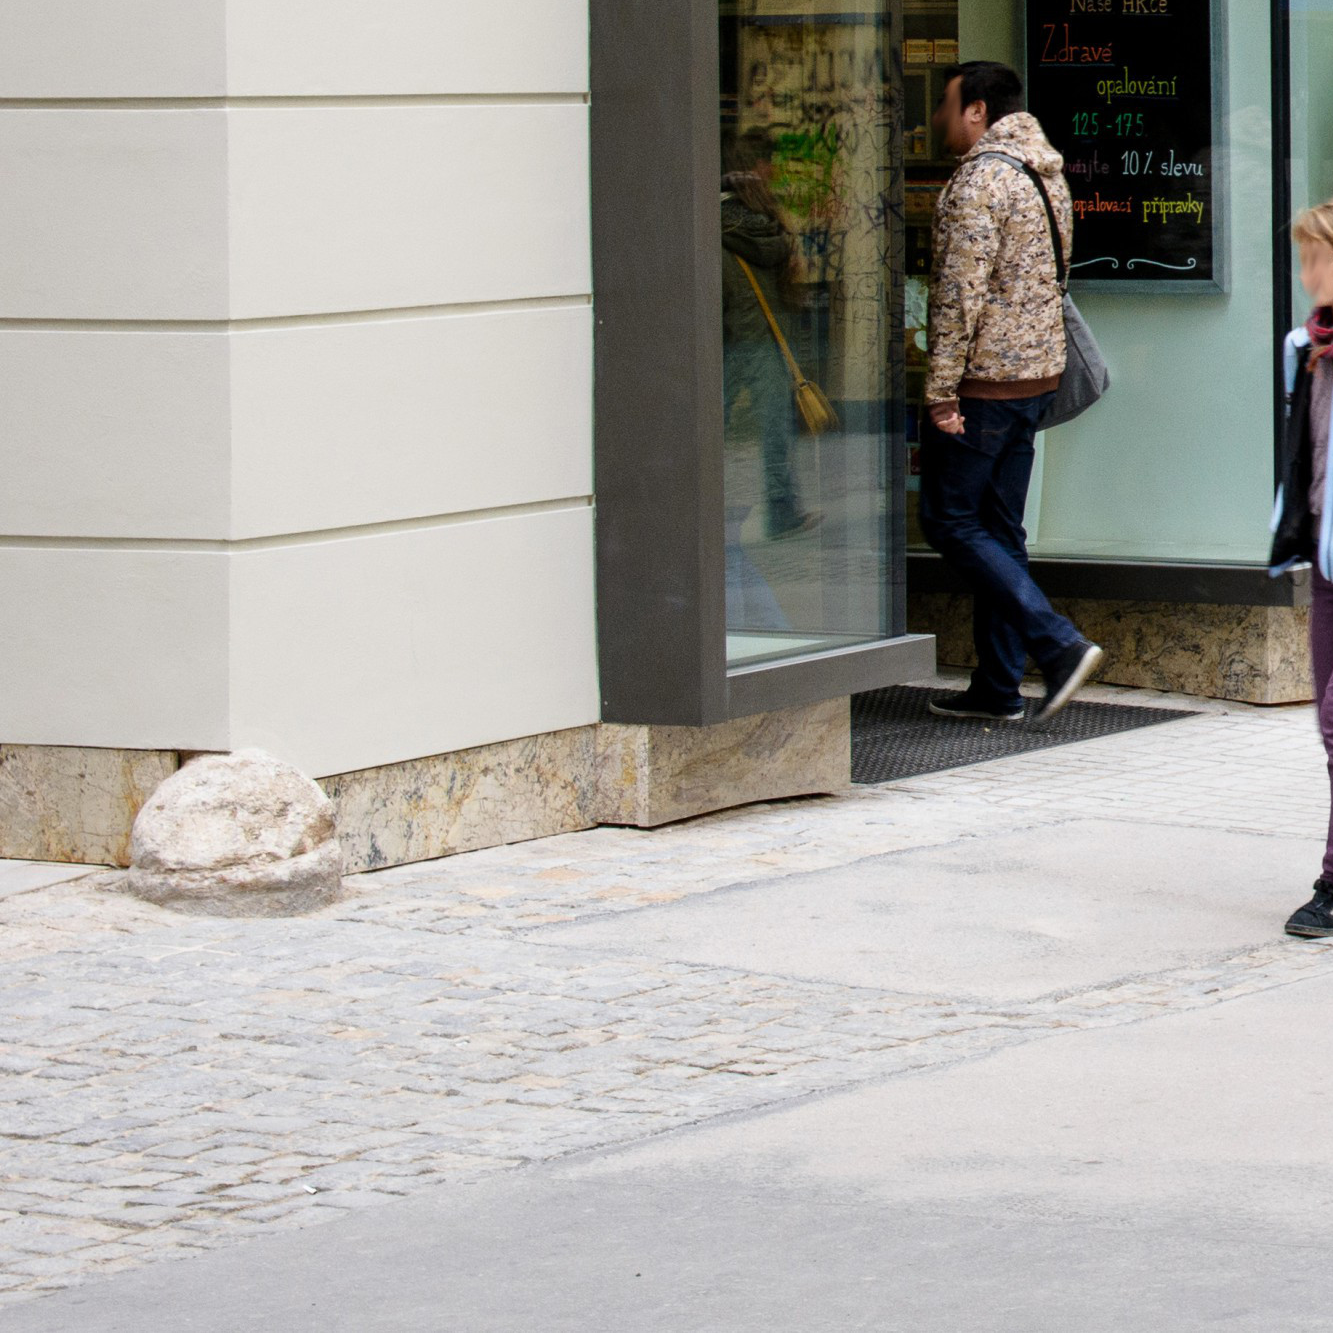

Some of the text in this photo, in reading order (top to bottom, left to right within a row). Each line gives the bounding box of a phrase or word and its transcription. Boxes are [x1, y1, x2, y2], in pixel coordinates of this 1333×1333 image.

[1041, 23, 1113, 63] Zdravé
[1097, 66, 1178, 104] opalování
[1161, 149, 1204, 177] slevu
[1073, 192, 1204, 224] opalovací přípravky
